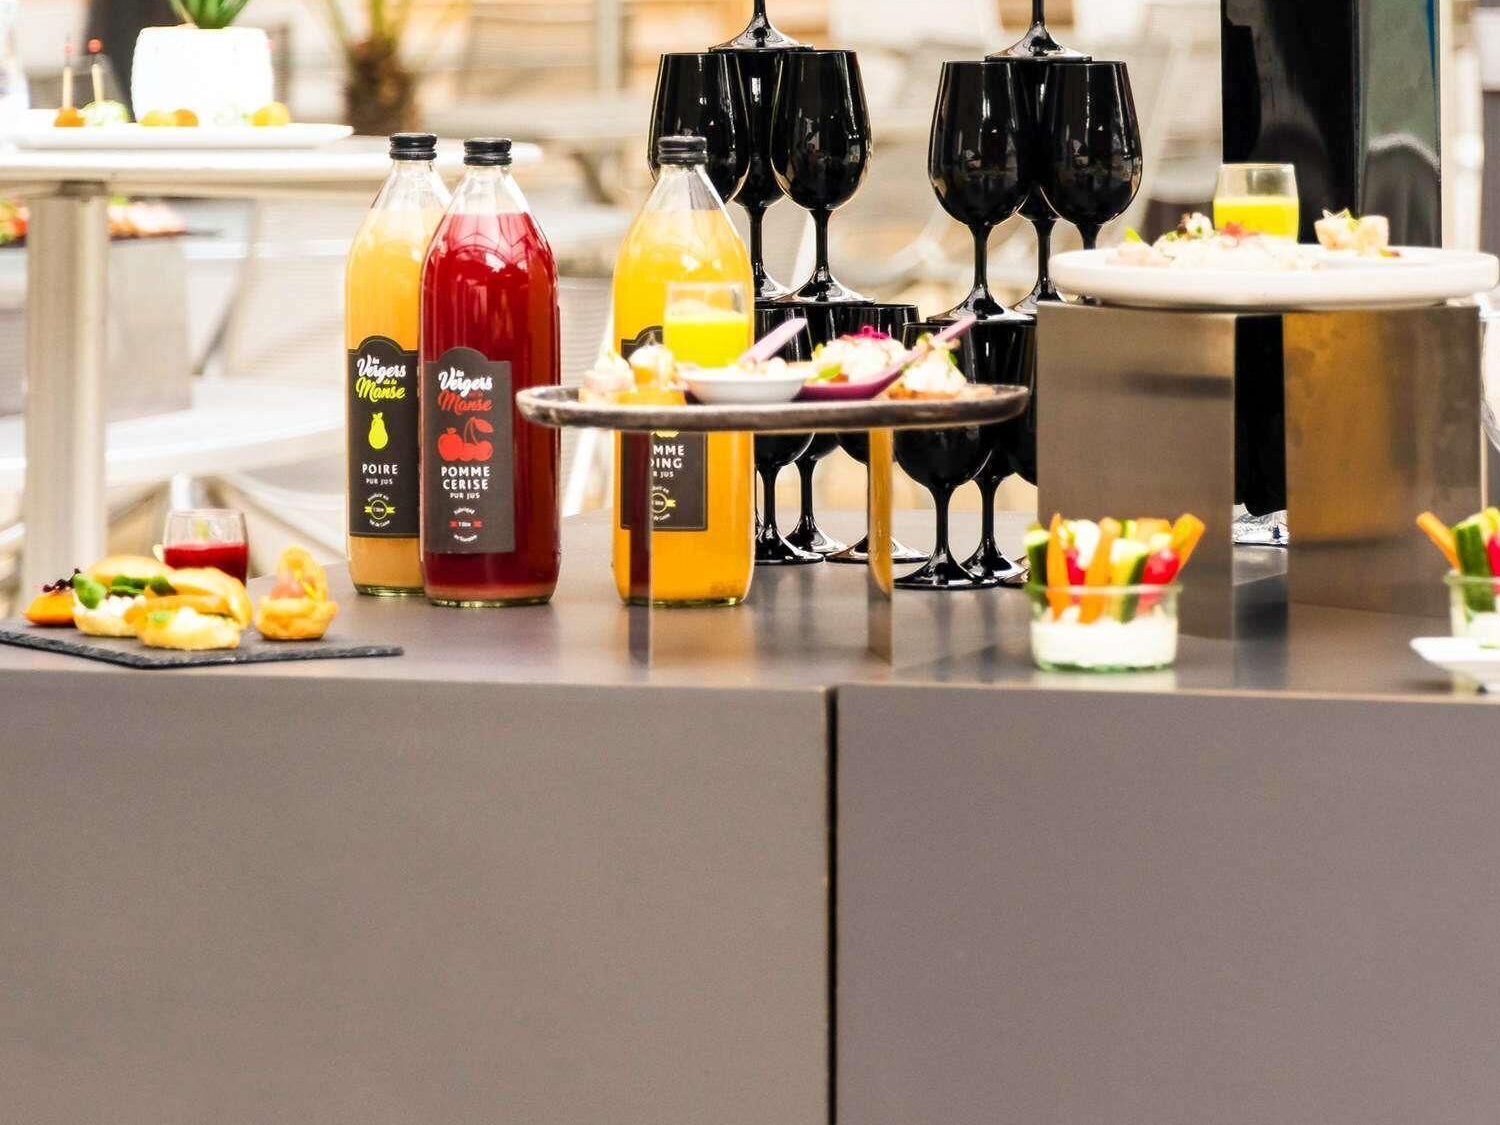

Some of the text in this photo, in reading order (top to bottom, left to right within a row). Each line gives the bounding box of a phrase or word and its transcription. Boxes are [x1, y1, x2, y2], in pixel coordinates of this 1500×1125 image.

[357, 354, 406, 384] Vergers
[438, 366, 493, 398] Vergers
[356, 376, 406, 403] Manse
[438, 389, 492, 416] Manse
[653, 445, 685, 456] MME
[650, 458, 682, 468] ING
[362, 463, 398, 475] POIRE
[440, 466, 490, 477] POMME
[442, 479, 489, 490] CERISE
[466, 492, 481, 500] JUS
